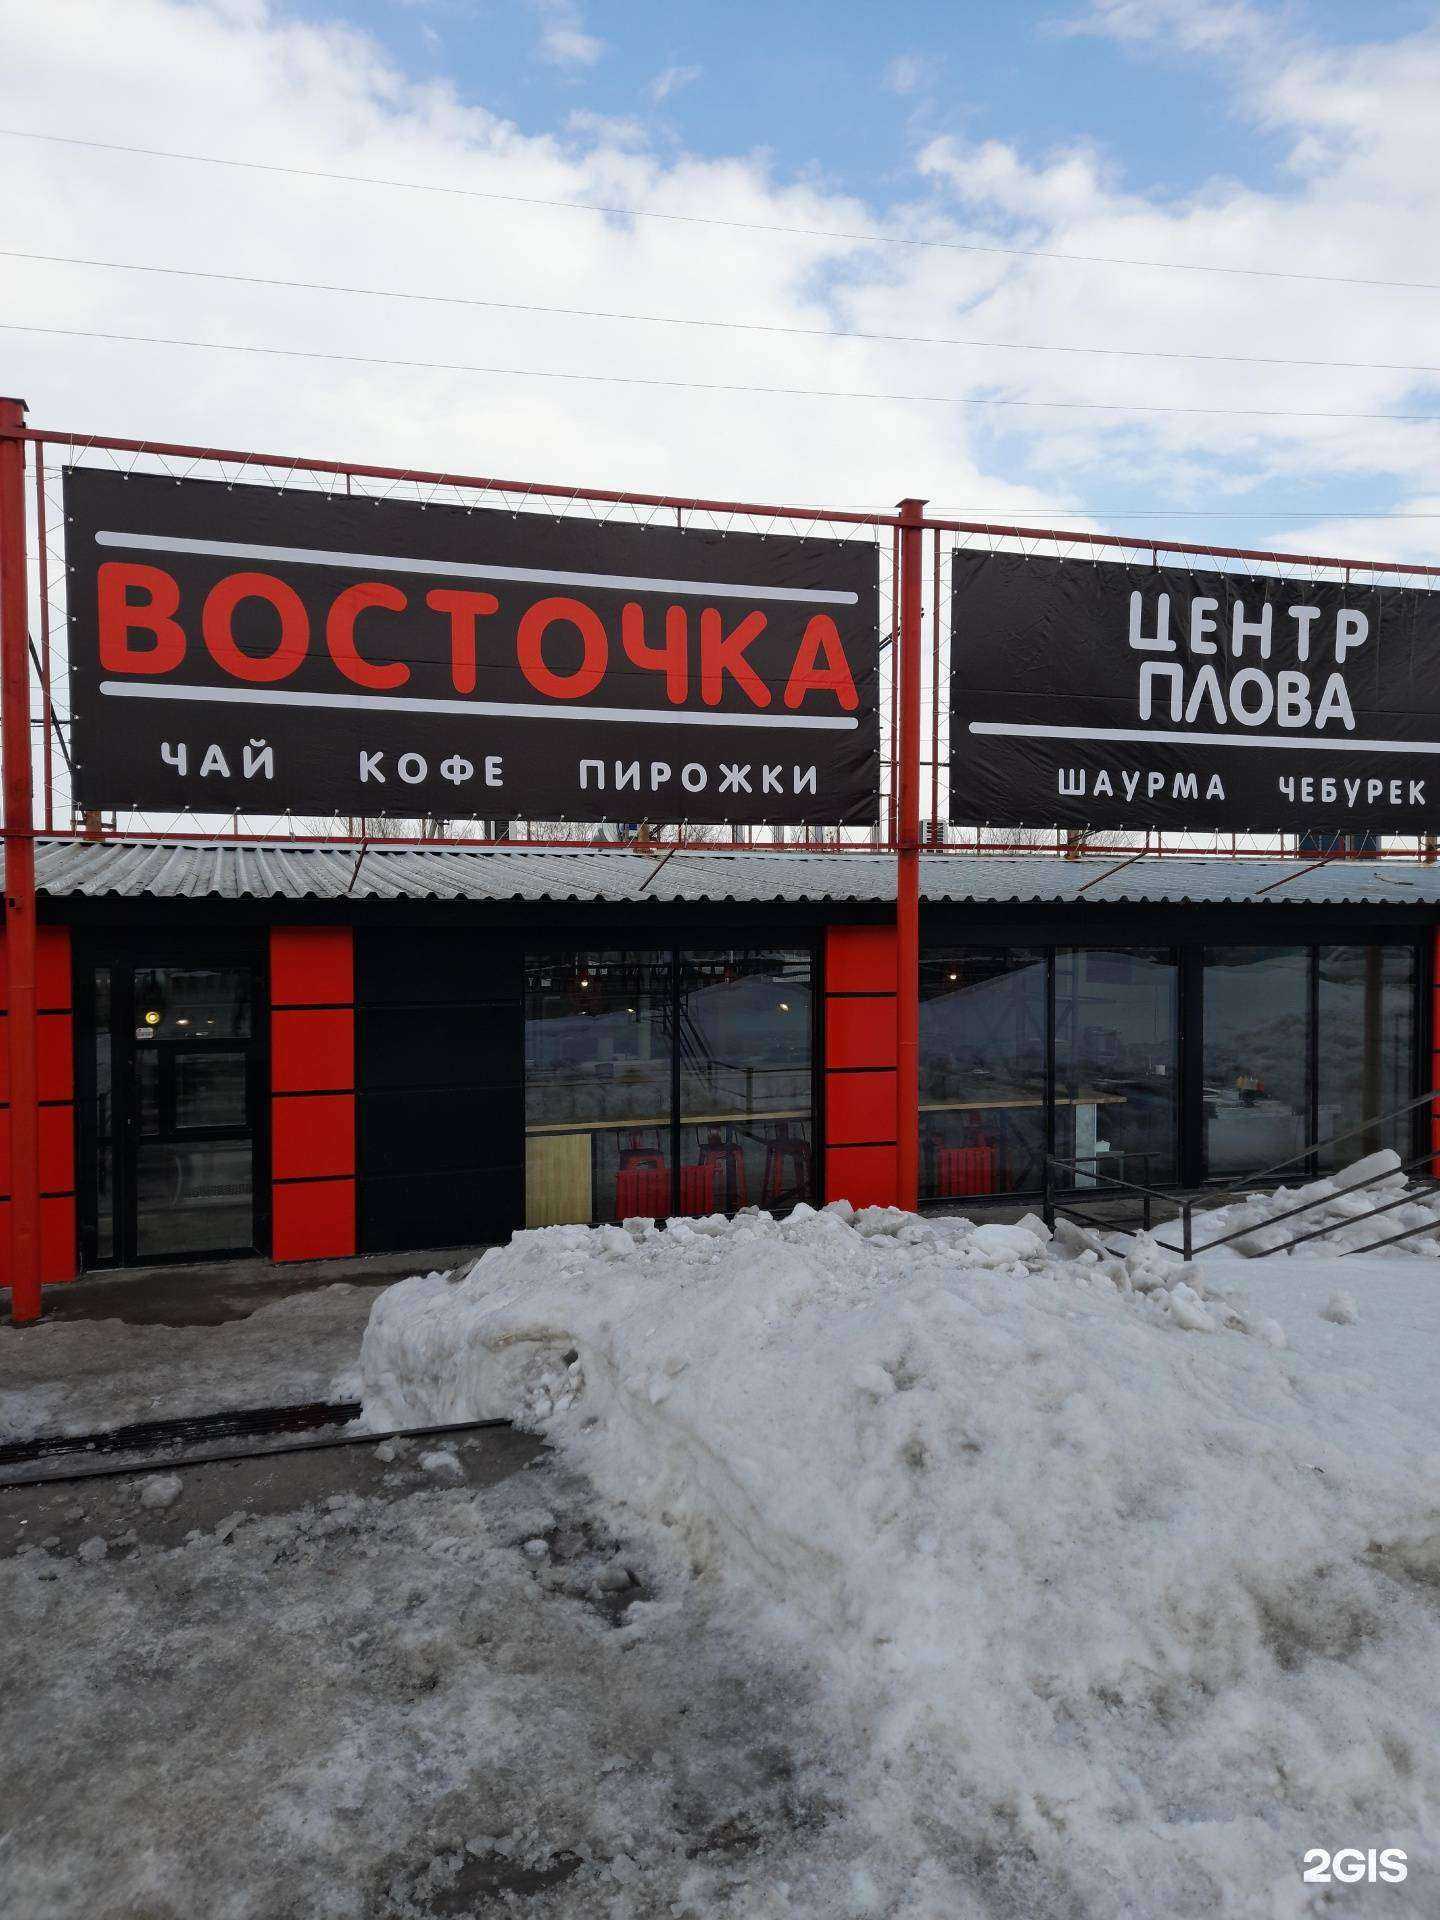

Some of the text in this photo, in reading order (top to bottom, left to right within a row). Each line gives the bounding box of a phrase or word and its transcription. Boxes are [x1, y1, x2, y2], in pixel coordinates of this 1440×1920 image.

[98, 562, 860, 711] ВОСТОЧКА
[1129, 590, 1369, 664] ЦЕНТР
[1139, 661, 1356, 731] ПЛОВА
[161, 738, 817, 795] ЧАЙ КОФЕ ПИРОЖКИ
[1058, 768, 1426, 808] ШАУРМА ЧЕБУРЕК
